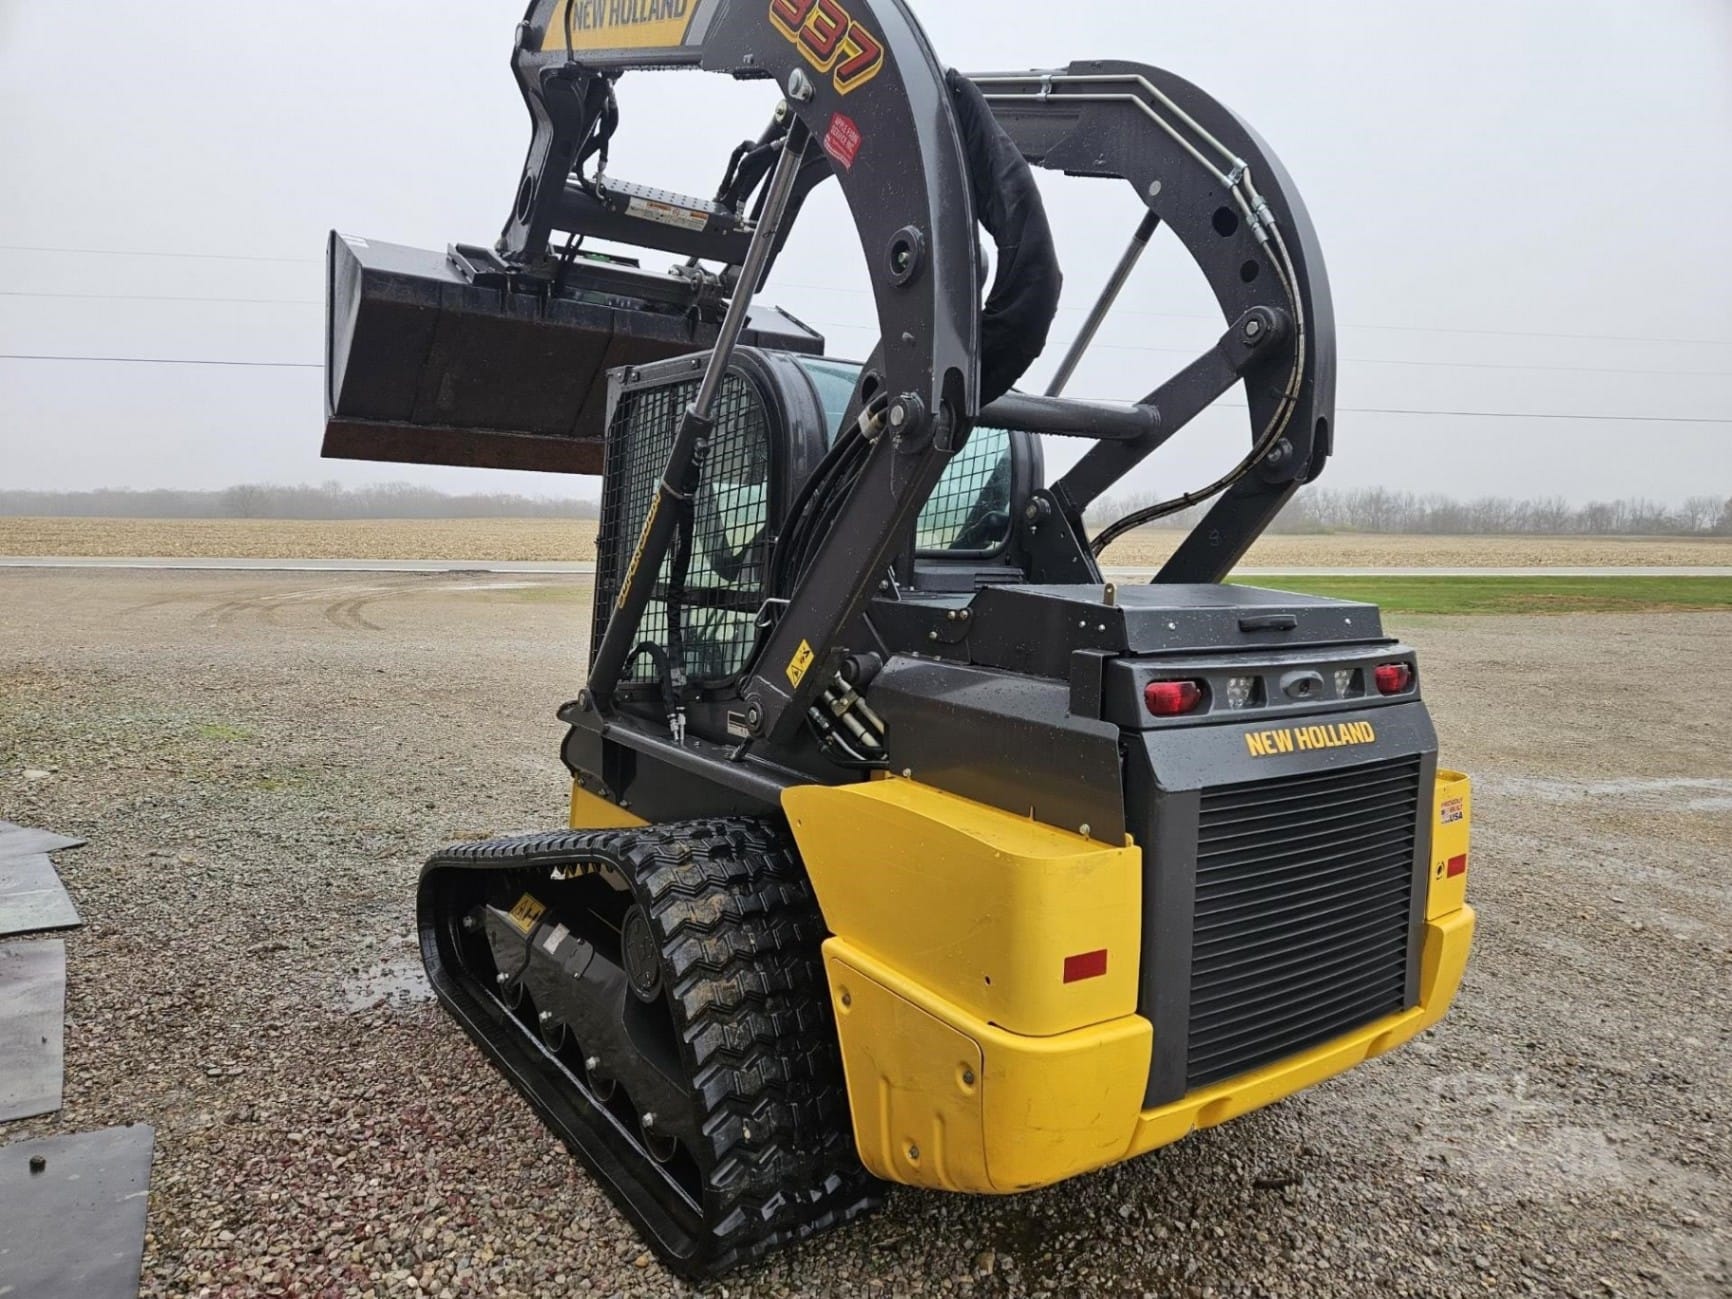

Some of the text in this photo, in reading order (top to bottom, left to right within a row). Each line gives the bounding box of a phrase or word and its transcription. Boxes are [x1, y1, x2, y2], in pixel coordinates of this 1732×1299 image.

[573, 0, 687, 31] NEW HOLLAND
[1244, 720, 1376, 757] NEW HOLLAND
